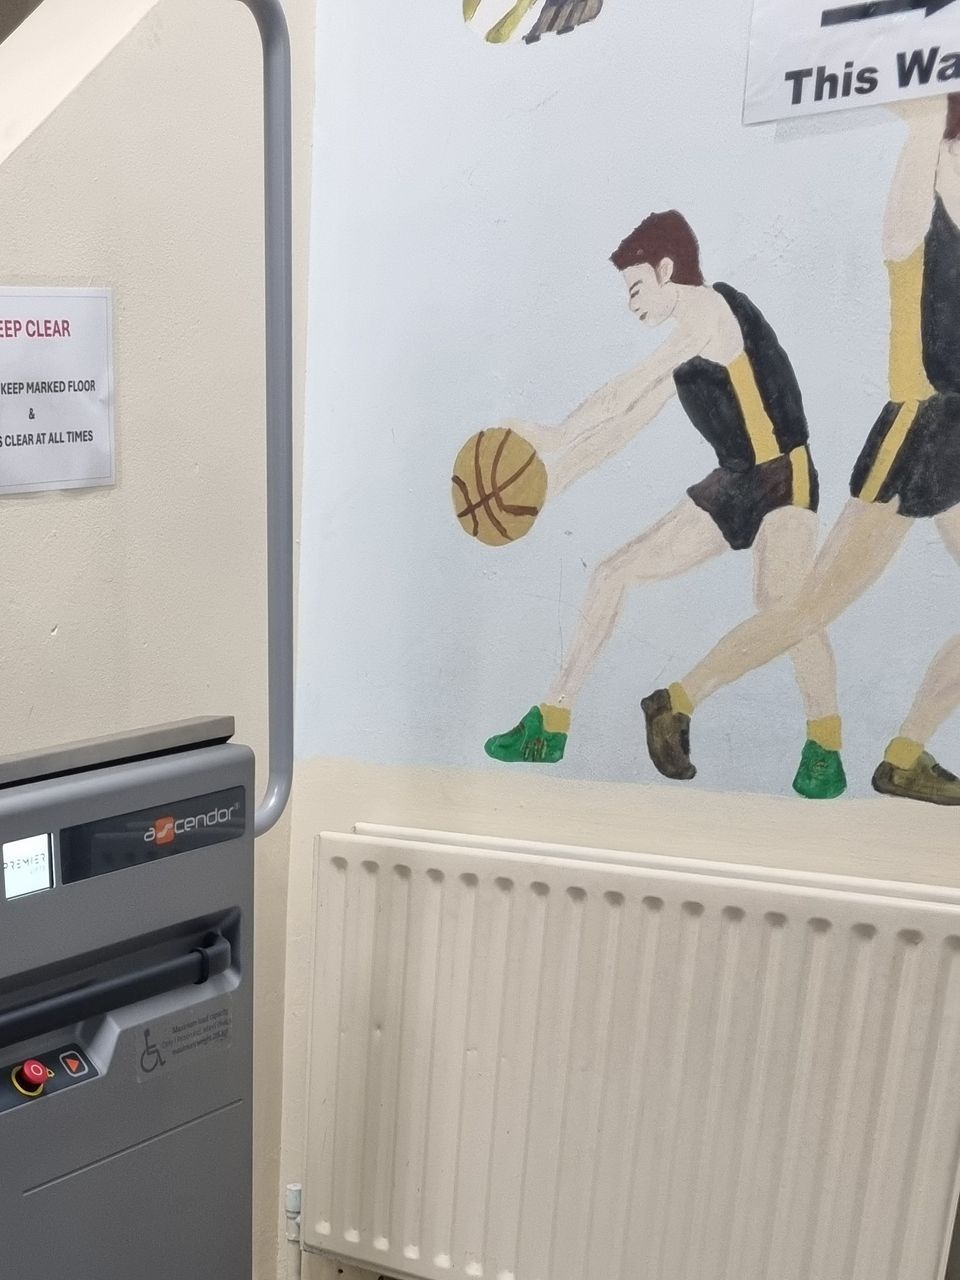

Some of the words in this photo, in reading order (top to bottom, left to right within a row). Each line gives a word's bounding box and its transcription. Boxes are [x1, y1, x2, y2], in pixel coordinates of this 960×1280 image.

[784, 61, 879, 105] This
[26, 319, 71, 338] CLEAR
[0, 382, 25, 395] KEEP
[26, 380, 66, 394] MARKED
[67, 379, 96, 393] FLOOR
[28, 407, 35, 420] &
[4, 433, 34, 447] CLEAR
[35, 432, 46, 445] AT
[47, 431, 65, 444] ALL
[66, 430, 94, 443] TIMES
[3, 852, 46, 871] PREMIER
